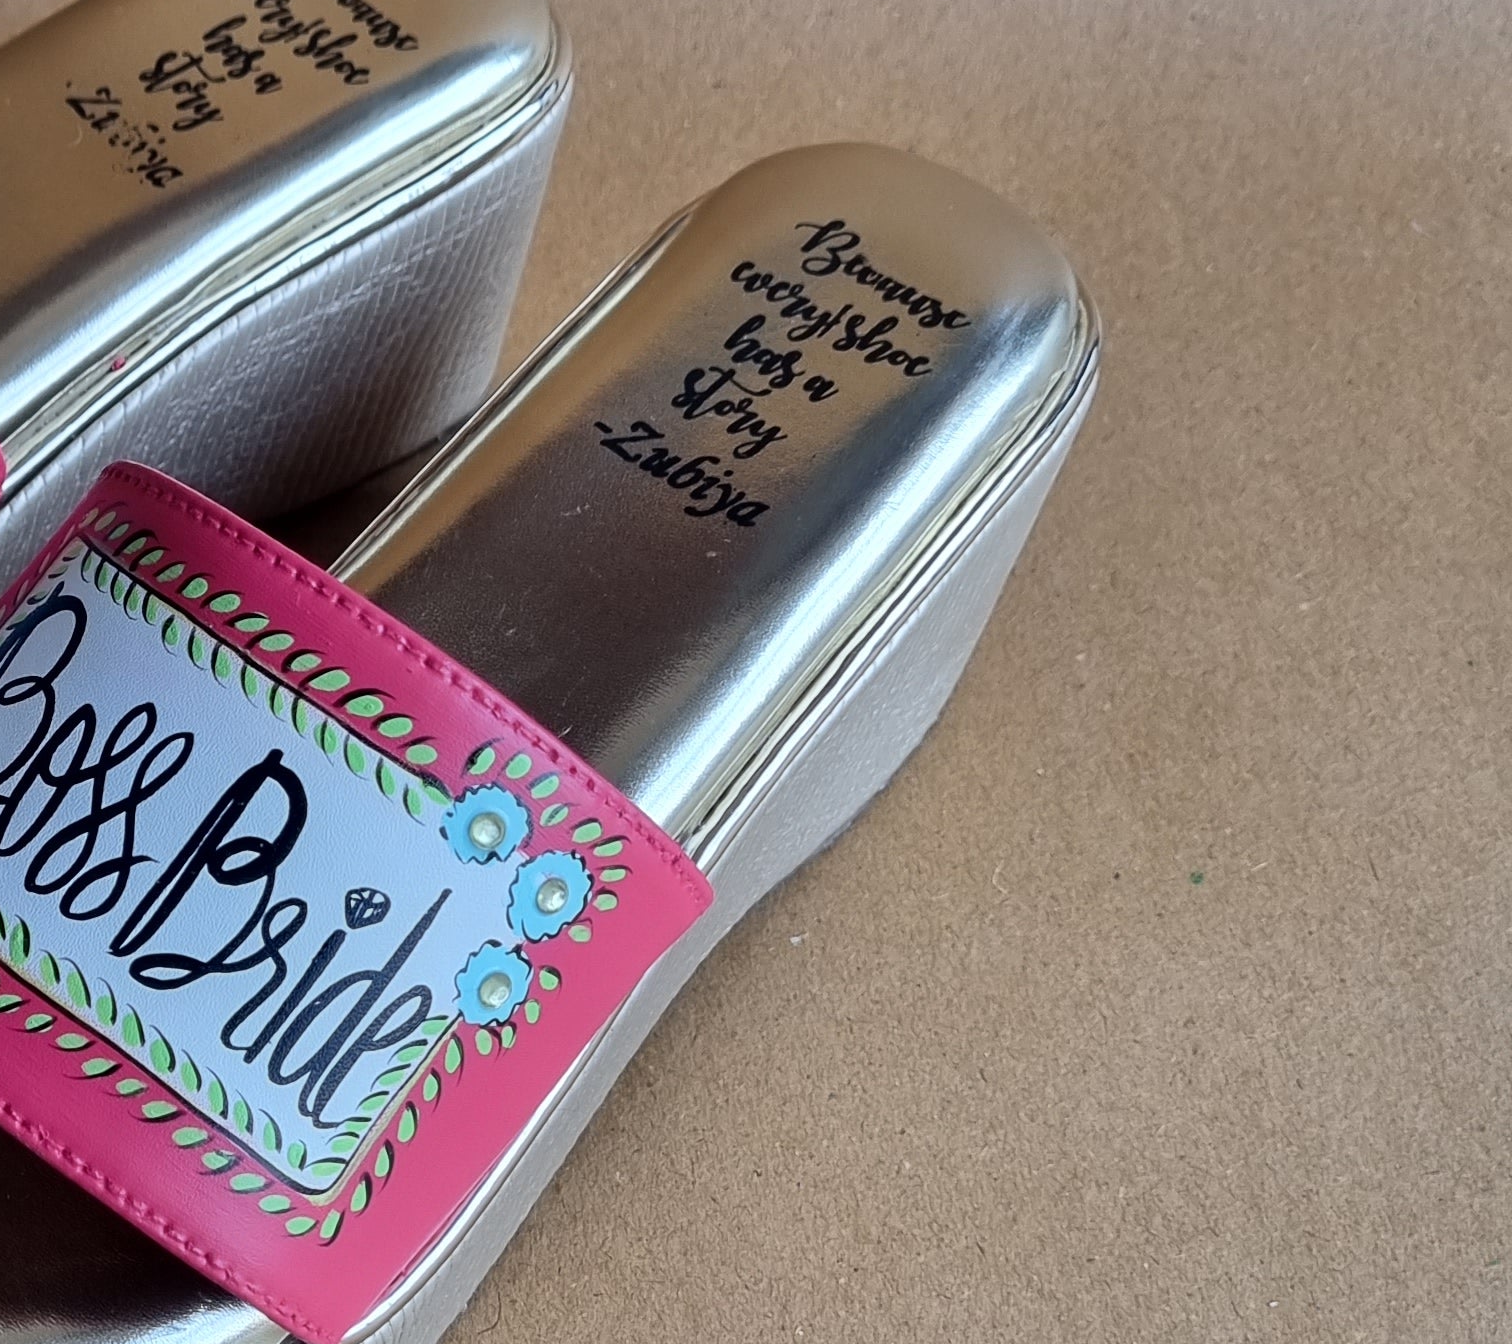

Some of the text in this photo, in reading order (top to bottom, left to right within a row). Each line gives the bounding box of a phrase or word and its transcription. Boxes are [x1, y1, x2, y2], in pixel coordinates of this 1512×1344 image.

[202, 16, 283, 95] has a
[794, 220, 972, 330] Because
[724, 314, 839, 403] has a
[832, 314, 933, 377] shoe
[107, 748, 451, 1129] Bride
